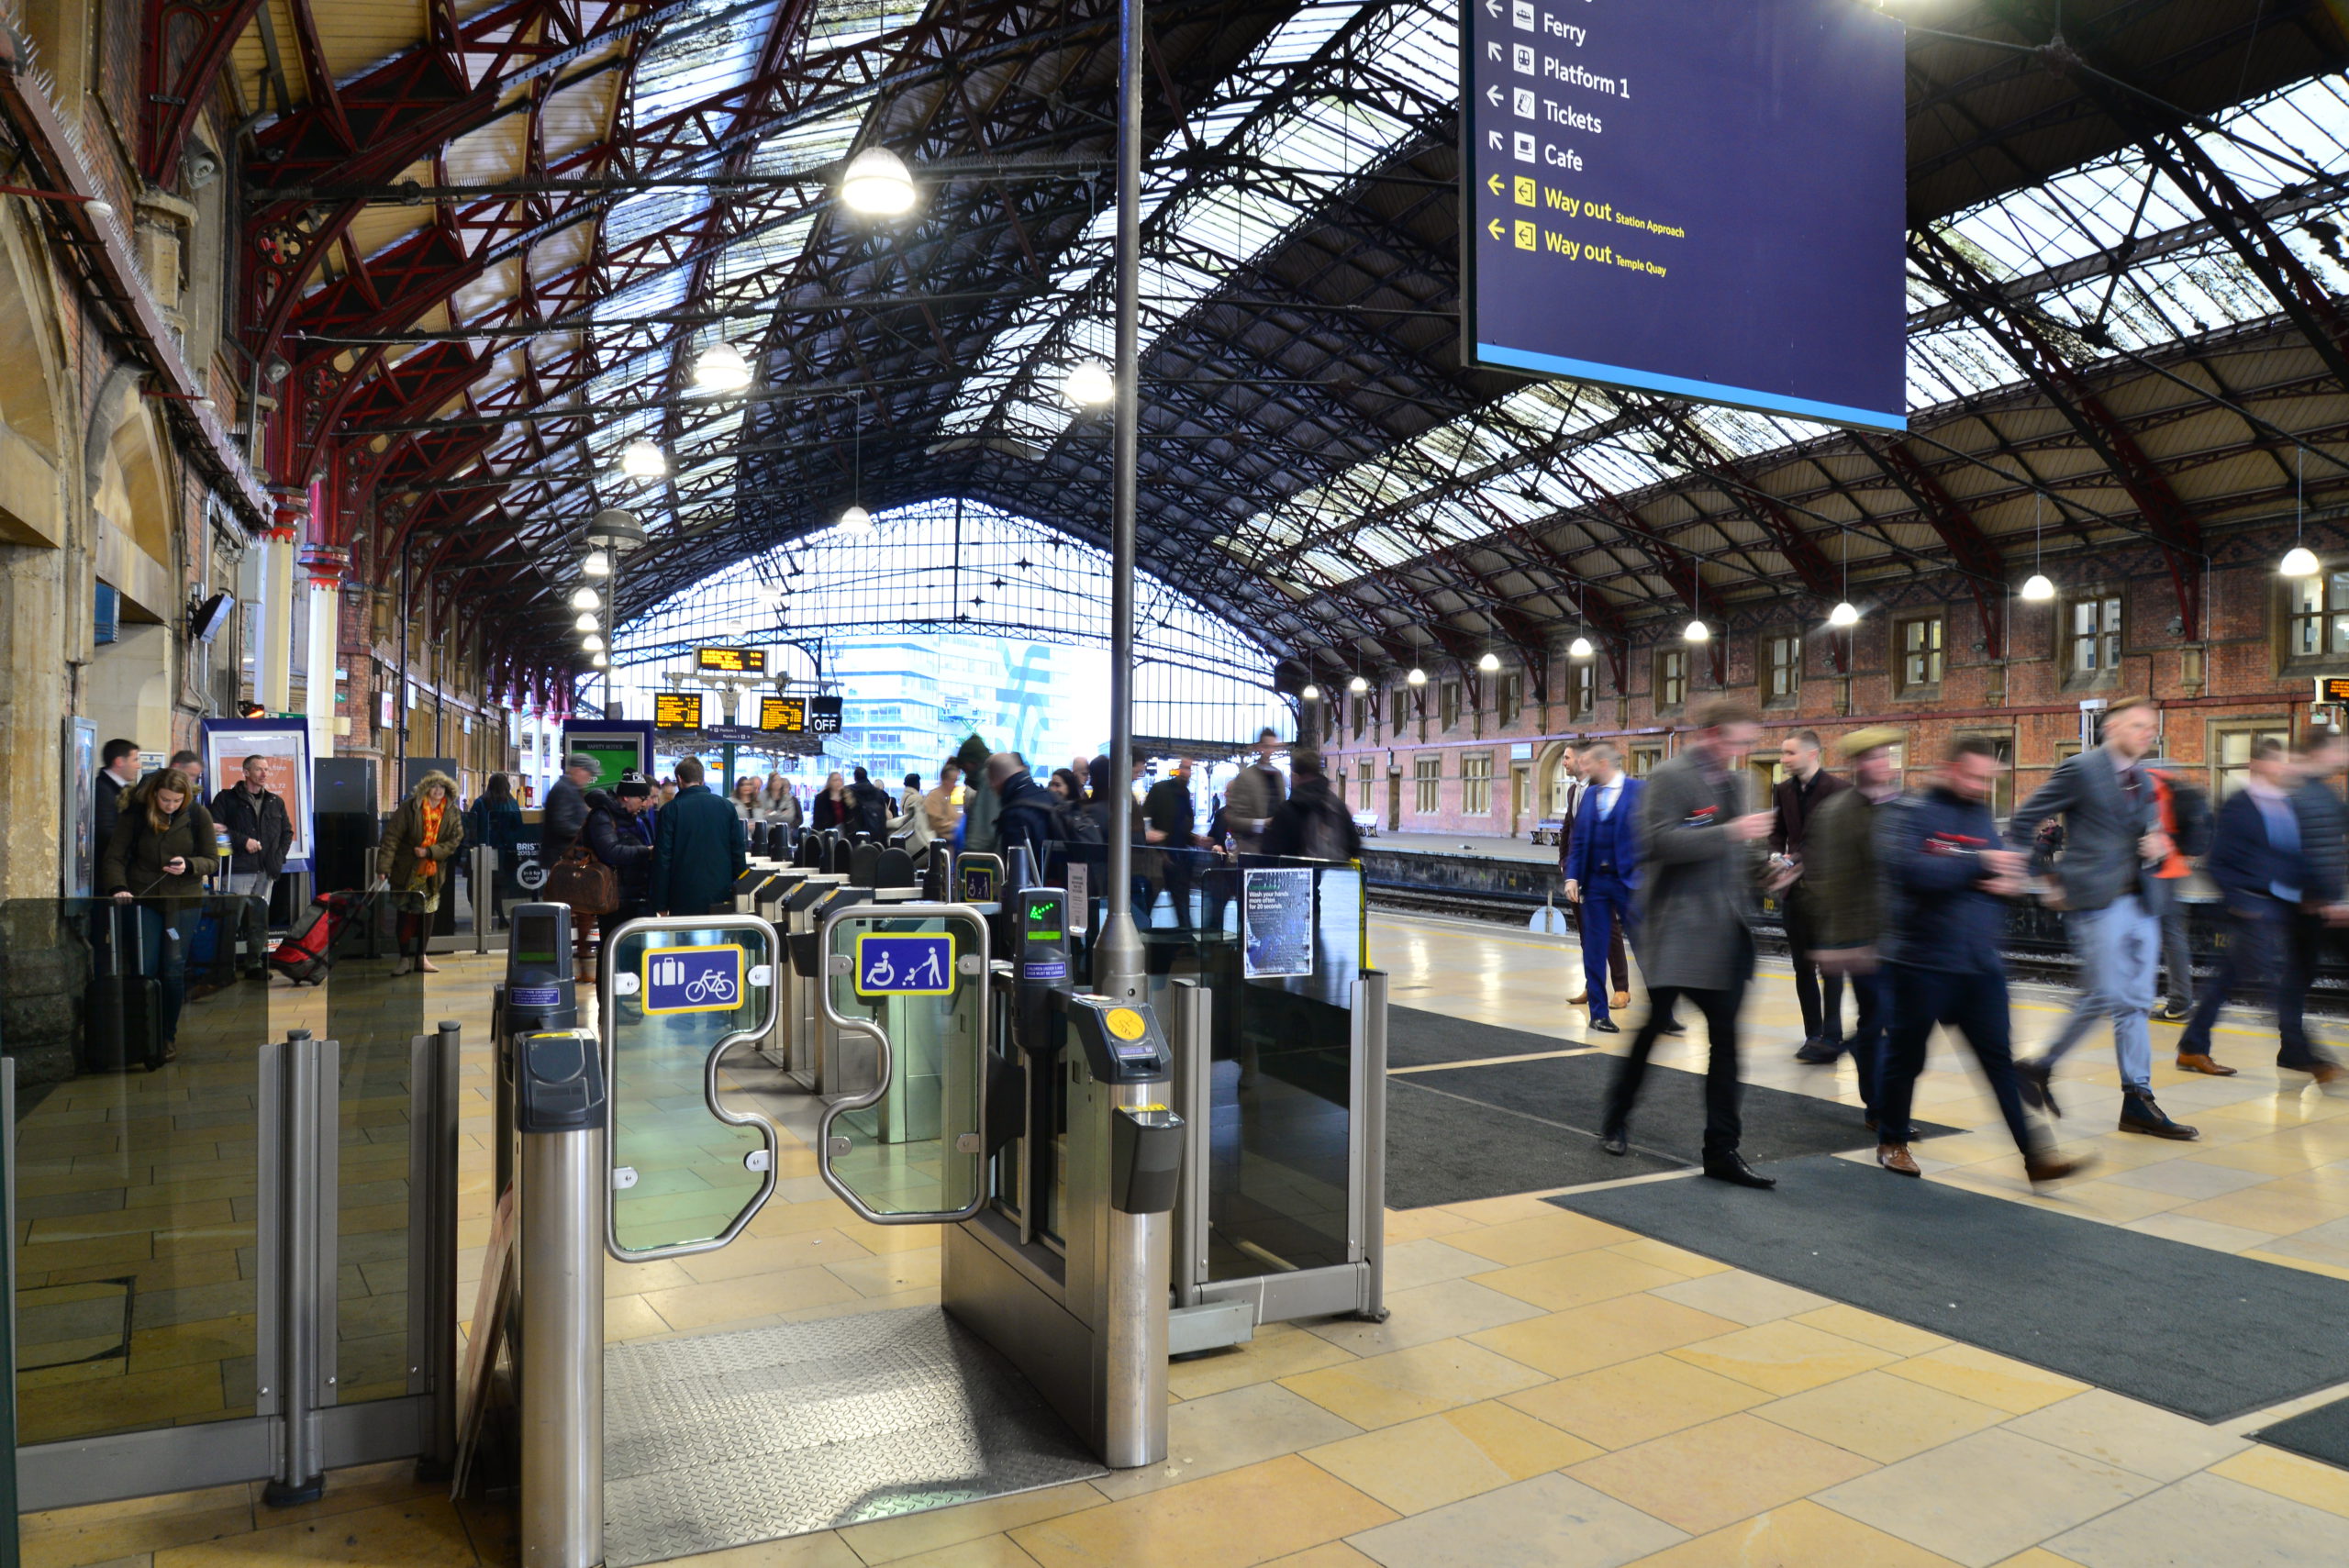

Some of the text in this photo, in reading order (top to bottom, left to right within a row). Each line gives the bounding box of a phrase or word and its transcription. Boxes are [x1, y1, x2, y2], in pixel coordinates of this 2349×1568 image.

[1543, 12, 1586, 48] Ferry
[1543, 55, 1631, 99] Platform 1
[1543, 98, 1602, 134] Tickets
[1544, 143, 1584, 172] Cafe
[1544, 186, 1685, 239] Way out Station Approach
[1544, 229, 1667, 278] Way out Temple Quay
[814, 719, 837, 731] OFF
